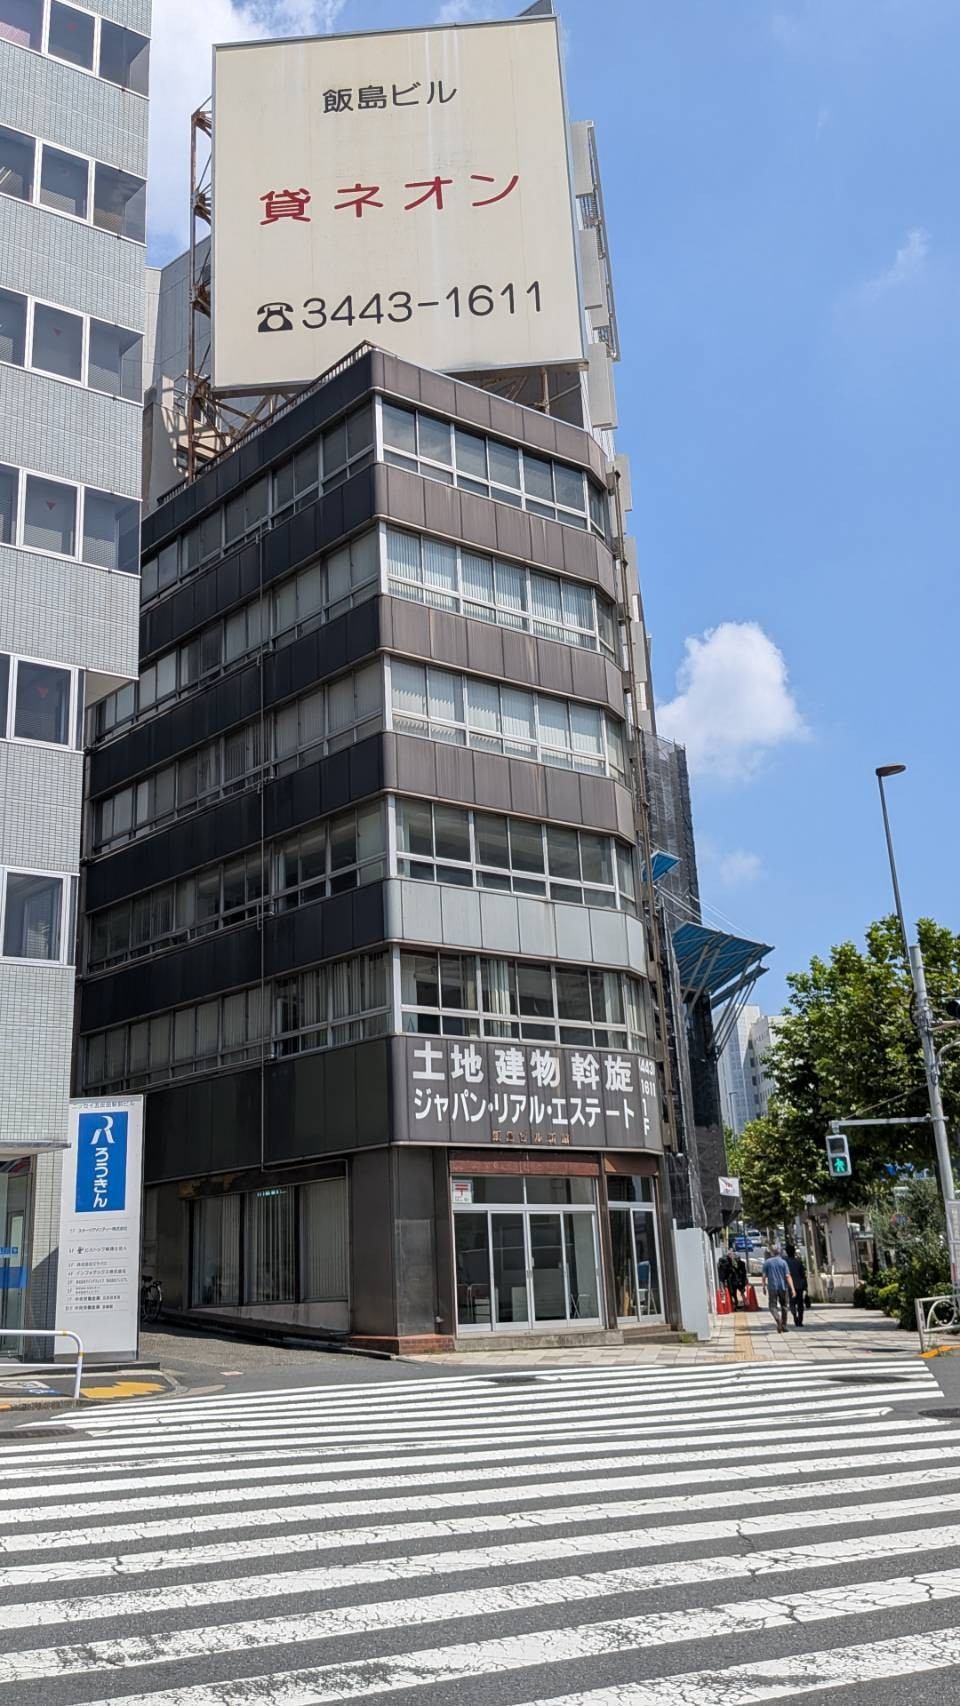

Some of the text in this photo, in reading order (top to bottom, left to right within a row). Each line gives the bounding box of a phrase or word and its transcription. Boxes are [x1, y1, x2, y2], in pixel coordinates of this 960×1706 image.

[322, 80, 457, 113] 飯島ビル
[259, 175, 519, 226] 貸ネオン
[302, 280, 541, 329] 3443-1611
[93, 1147, 109, 1208] ろうきん
